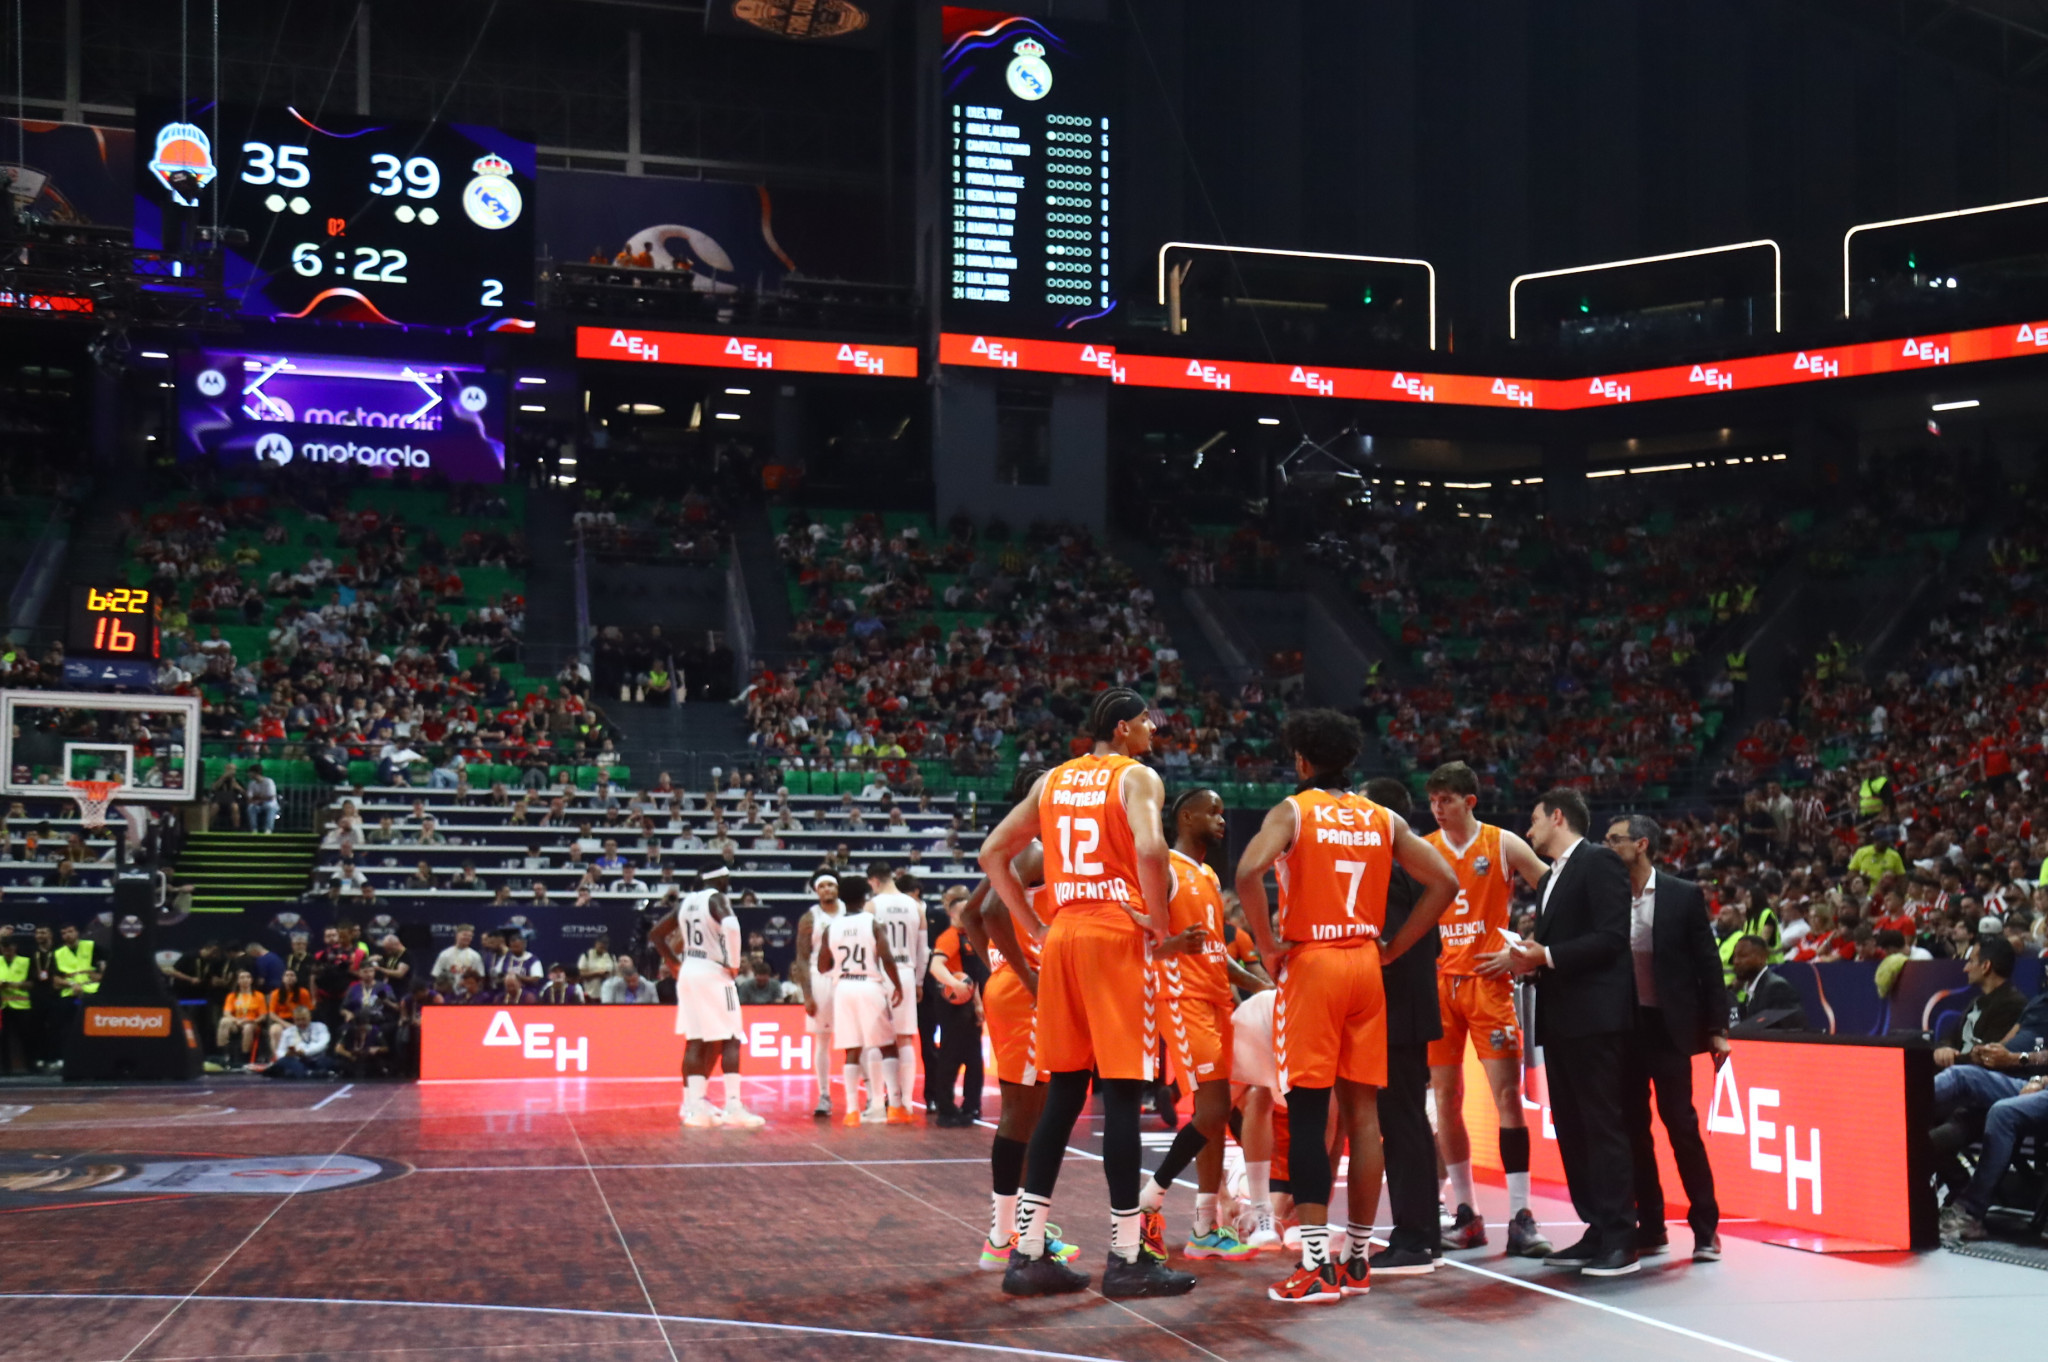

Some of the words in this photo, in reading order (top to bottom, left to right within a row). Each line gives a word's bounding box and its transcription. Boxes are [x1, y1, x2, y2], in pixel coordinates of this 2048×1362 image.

[953, 138, 960, 150] 7
[241, 142, 311, 188] 35
[370, 154, 441, 199] 39
[953, 188, 965, 200] 11
[953, 205, 965, 217] 12
[953, 237, 965, 249] 14
[953, 254, 965, 266] 16
[480, 280, 503, 307] 2
[952, 287, 964, 299] 24
[302, 442, 430, 468] motorola
[87, 588, 149, 613] 6:22
[94, 617, 136, 652] 16
[1060, 768, 1110, 786] SAKO
[1053, 789, 1106, 805] PAMESA
[1314, 805, 1374, 826] KEY
[1056, 815, 1105, 876] 12
[1317, 828, 1381, 846] PAMESA
[1335, 859, 1367, 918] 7
[1455, 889, 1469, 915] 5
[685, 919, 703, 946] 16
[889, 921, 906, 948] 11
[837, 944, 866, 972] 24
[94, 1014, 163, 1030] trendyol
